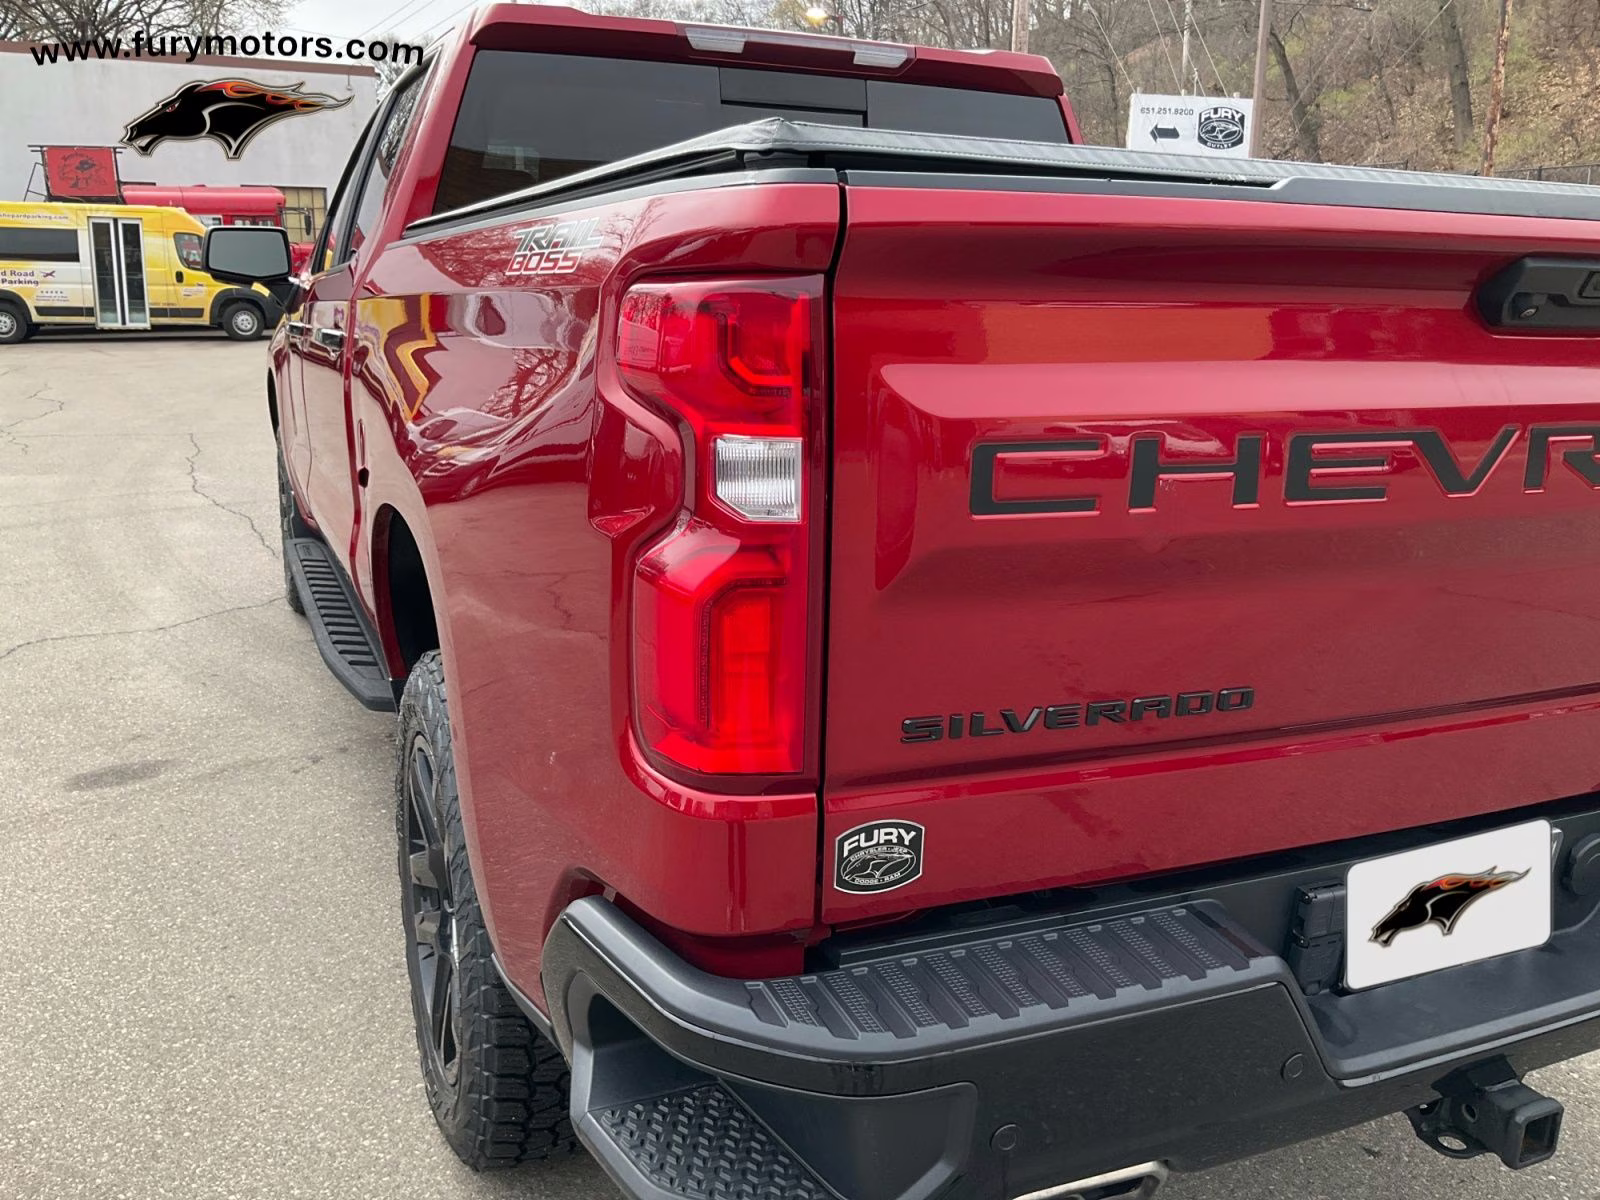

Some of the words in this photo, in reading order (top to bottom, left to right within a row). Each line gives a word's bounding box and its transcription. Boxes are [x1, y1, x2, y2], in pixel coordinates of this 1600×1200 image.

[1140, 106, 1194, 116] 651.251.8200
[1200, 107, 1243, 122] FURY
[513, 217, 604, 253] TRAIL
[10, 269, 35, 277] Road
[505, 249, 582, 275] BOSS
[1, 278, 39, 286] Parking
[969, 424, 1600, 520] CHEVR
[901, 686, 1254, 744] SILVERADO
[843, 828, 917, 858] FURY
